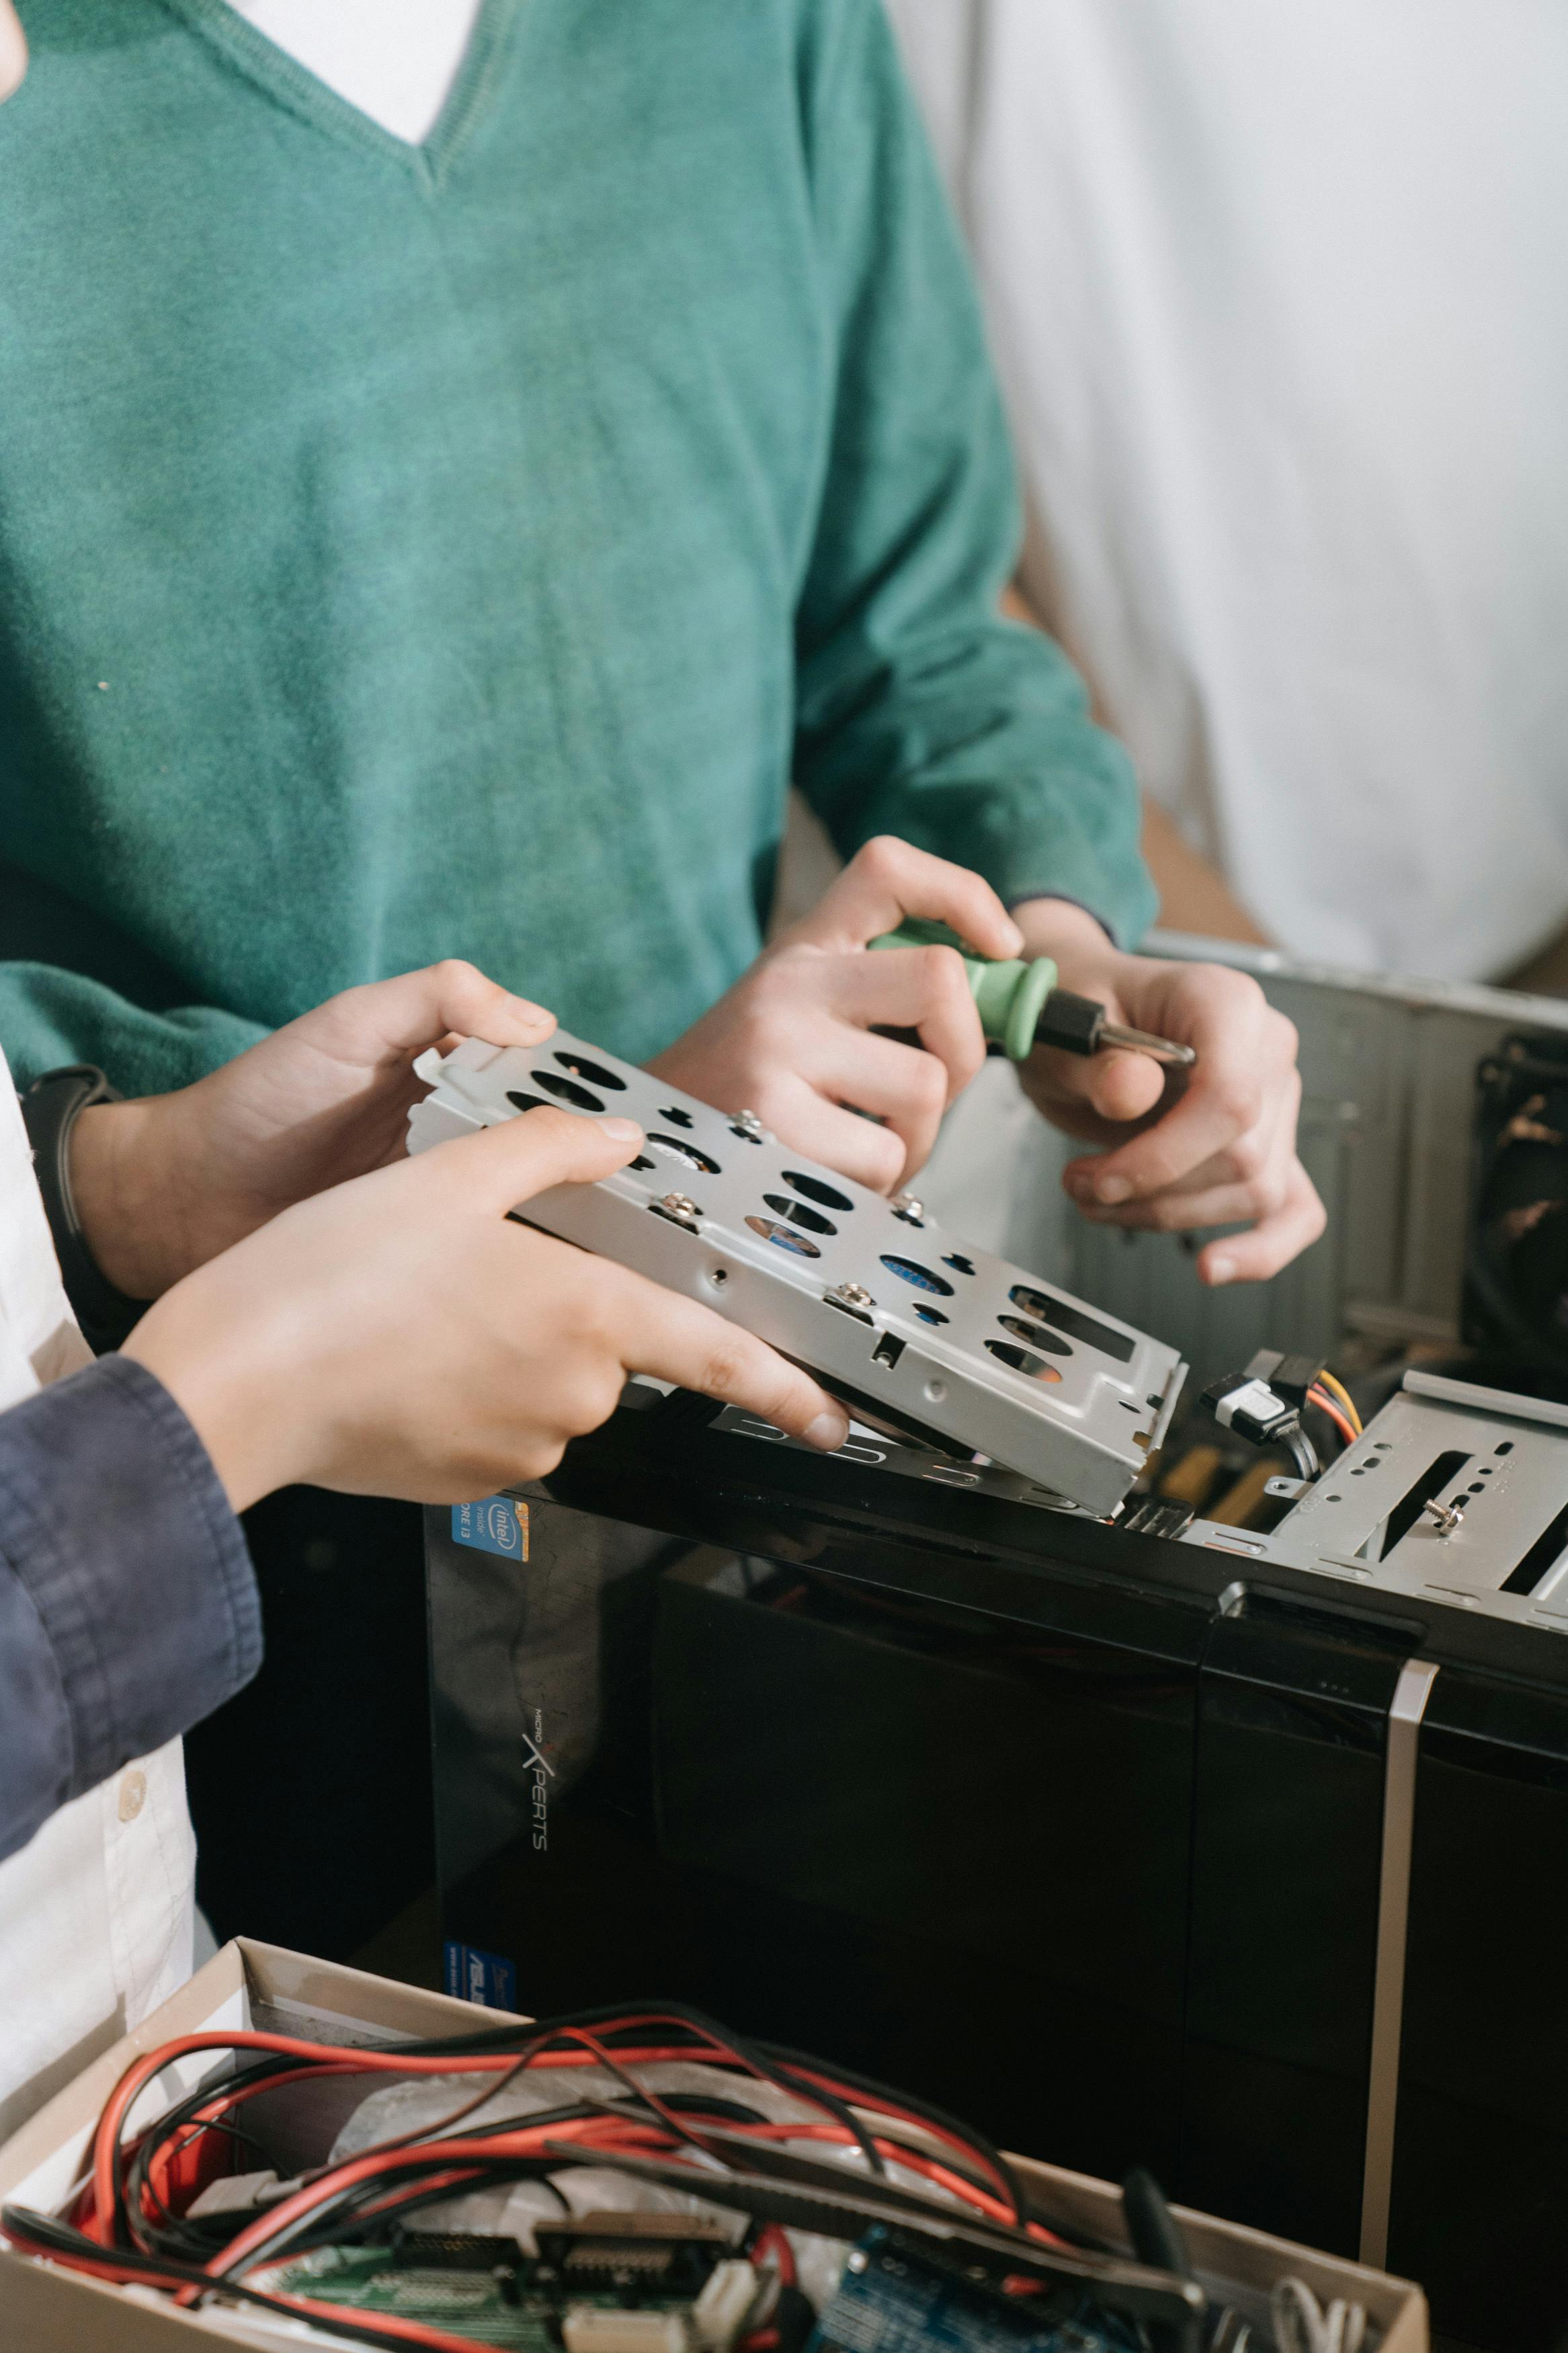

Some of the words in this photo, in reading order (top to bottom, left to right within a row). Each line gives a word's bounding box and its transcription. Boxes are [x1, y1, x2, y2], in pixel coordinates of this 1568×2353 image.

[461, 1503, 470, 1525] ORE
[477, 1506, 485, 1533] inside
[496, 1510, 510, 1543] intel
[461, 1527, 470, 1539] i3
[522, 1733, 556, 1851] XPERTS
